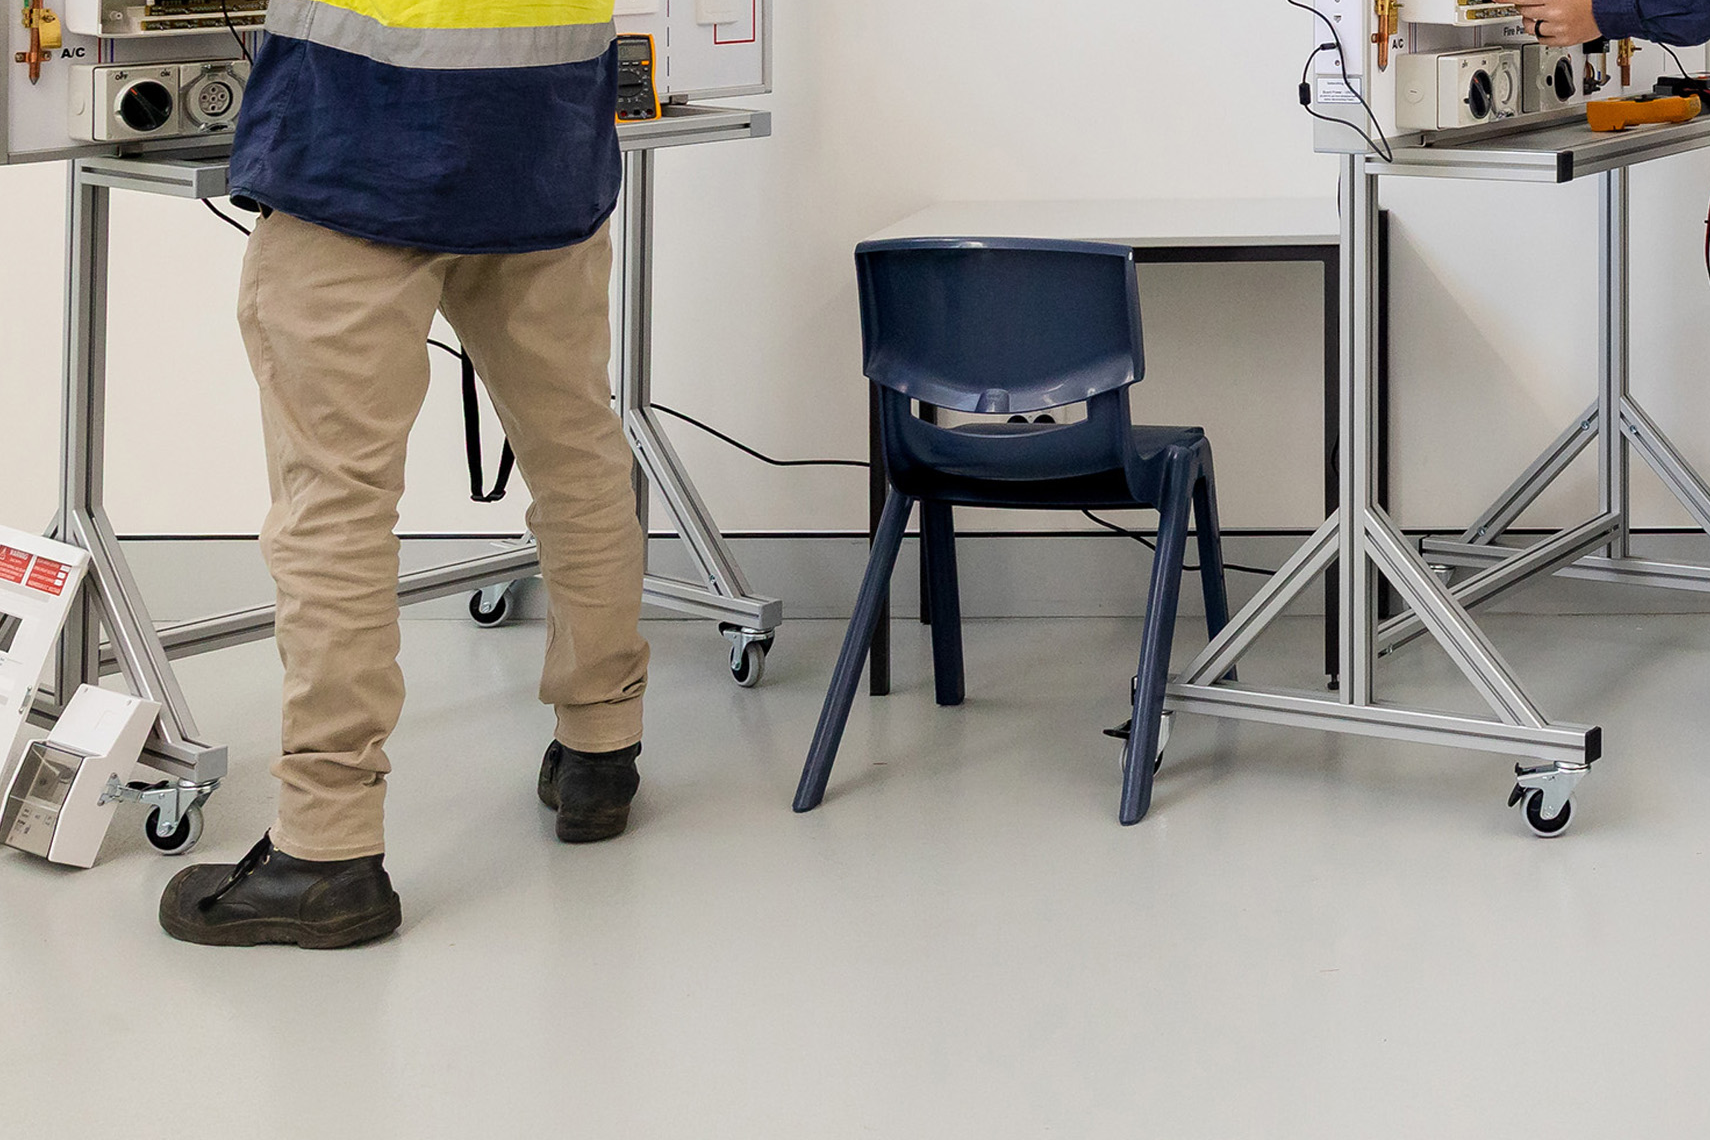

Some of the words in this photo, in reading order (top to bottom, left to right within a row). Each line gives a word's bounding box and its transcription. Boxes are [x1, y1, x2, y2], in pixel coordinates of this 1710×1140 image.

[1503, 27, 1515, 37] Fire
[1516, 24, 1524, 35] Pu
[61, 47, 86, 59] A/C
